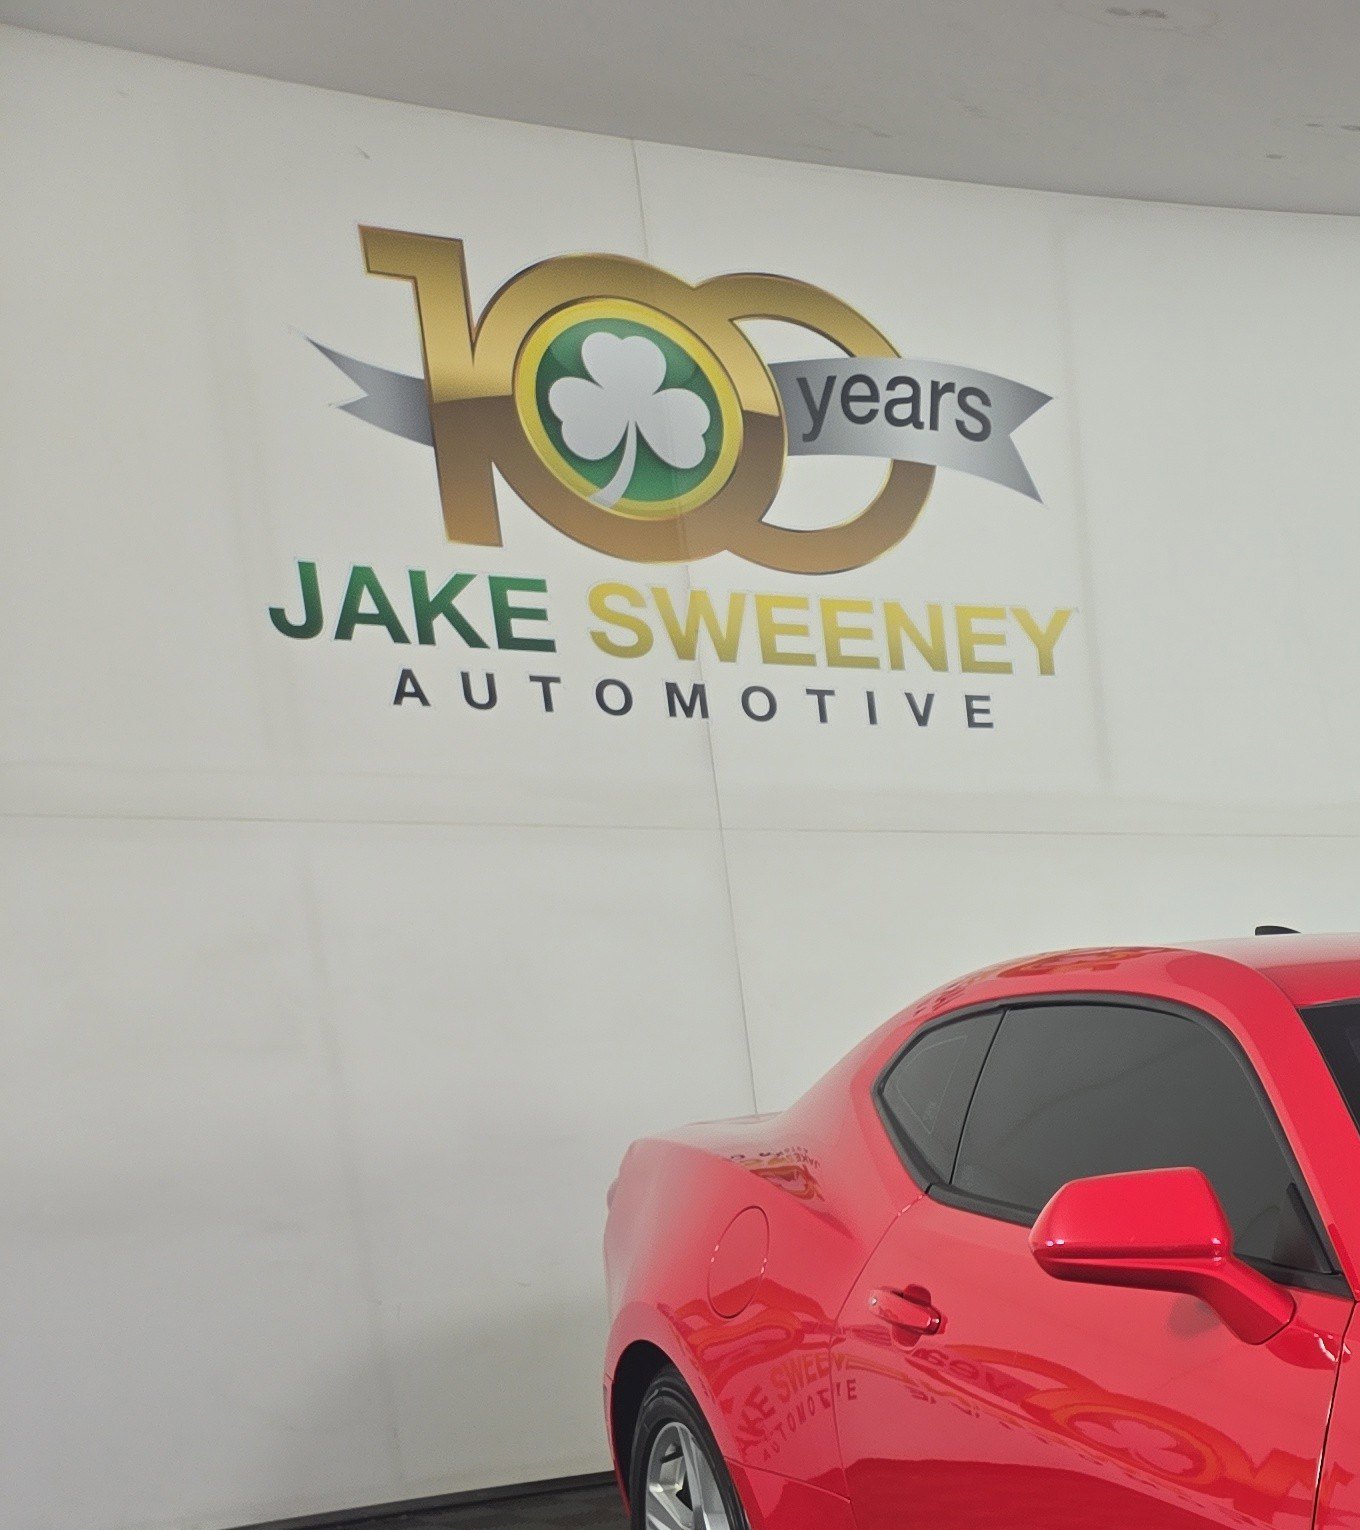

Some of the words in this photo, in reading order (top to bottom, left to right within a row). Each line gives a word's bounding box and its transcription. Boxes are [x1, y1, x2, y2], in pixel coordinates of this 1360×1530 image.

[358, 224, 938, 575] 100
[796, 371, 994, 444] years
[268, 560, 557, 654] JAKE
[587, 582, 1073, 676] SWEENEY
[392, 668, 995, 729] AUTOMOTIVE
